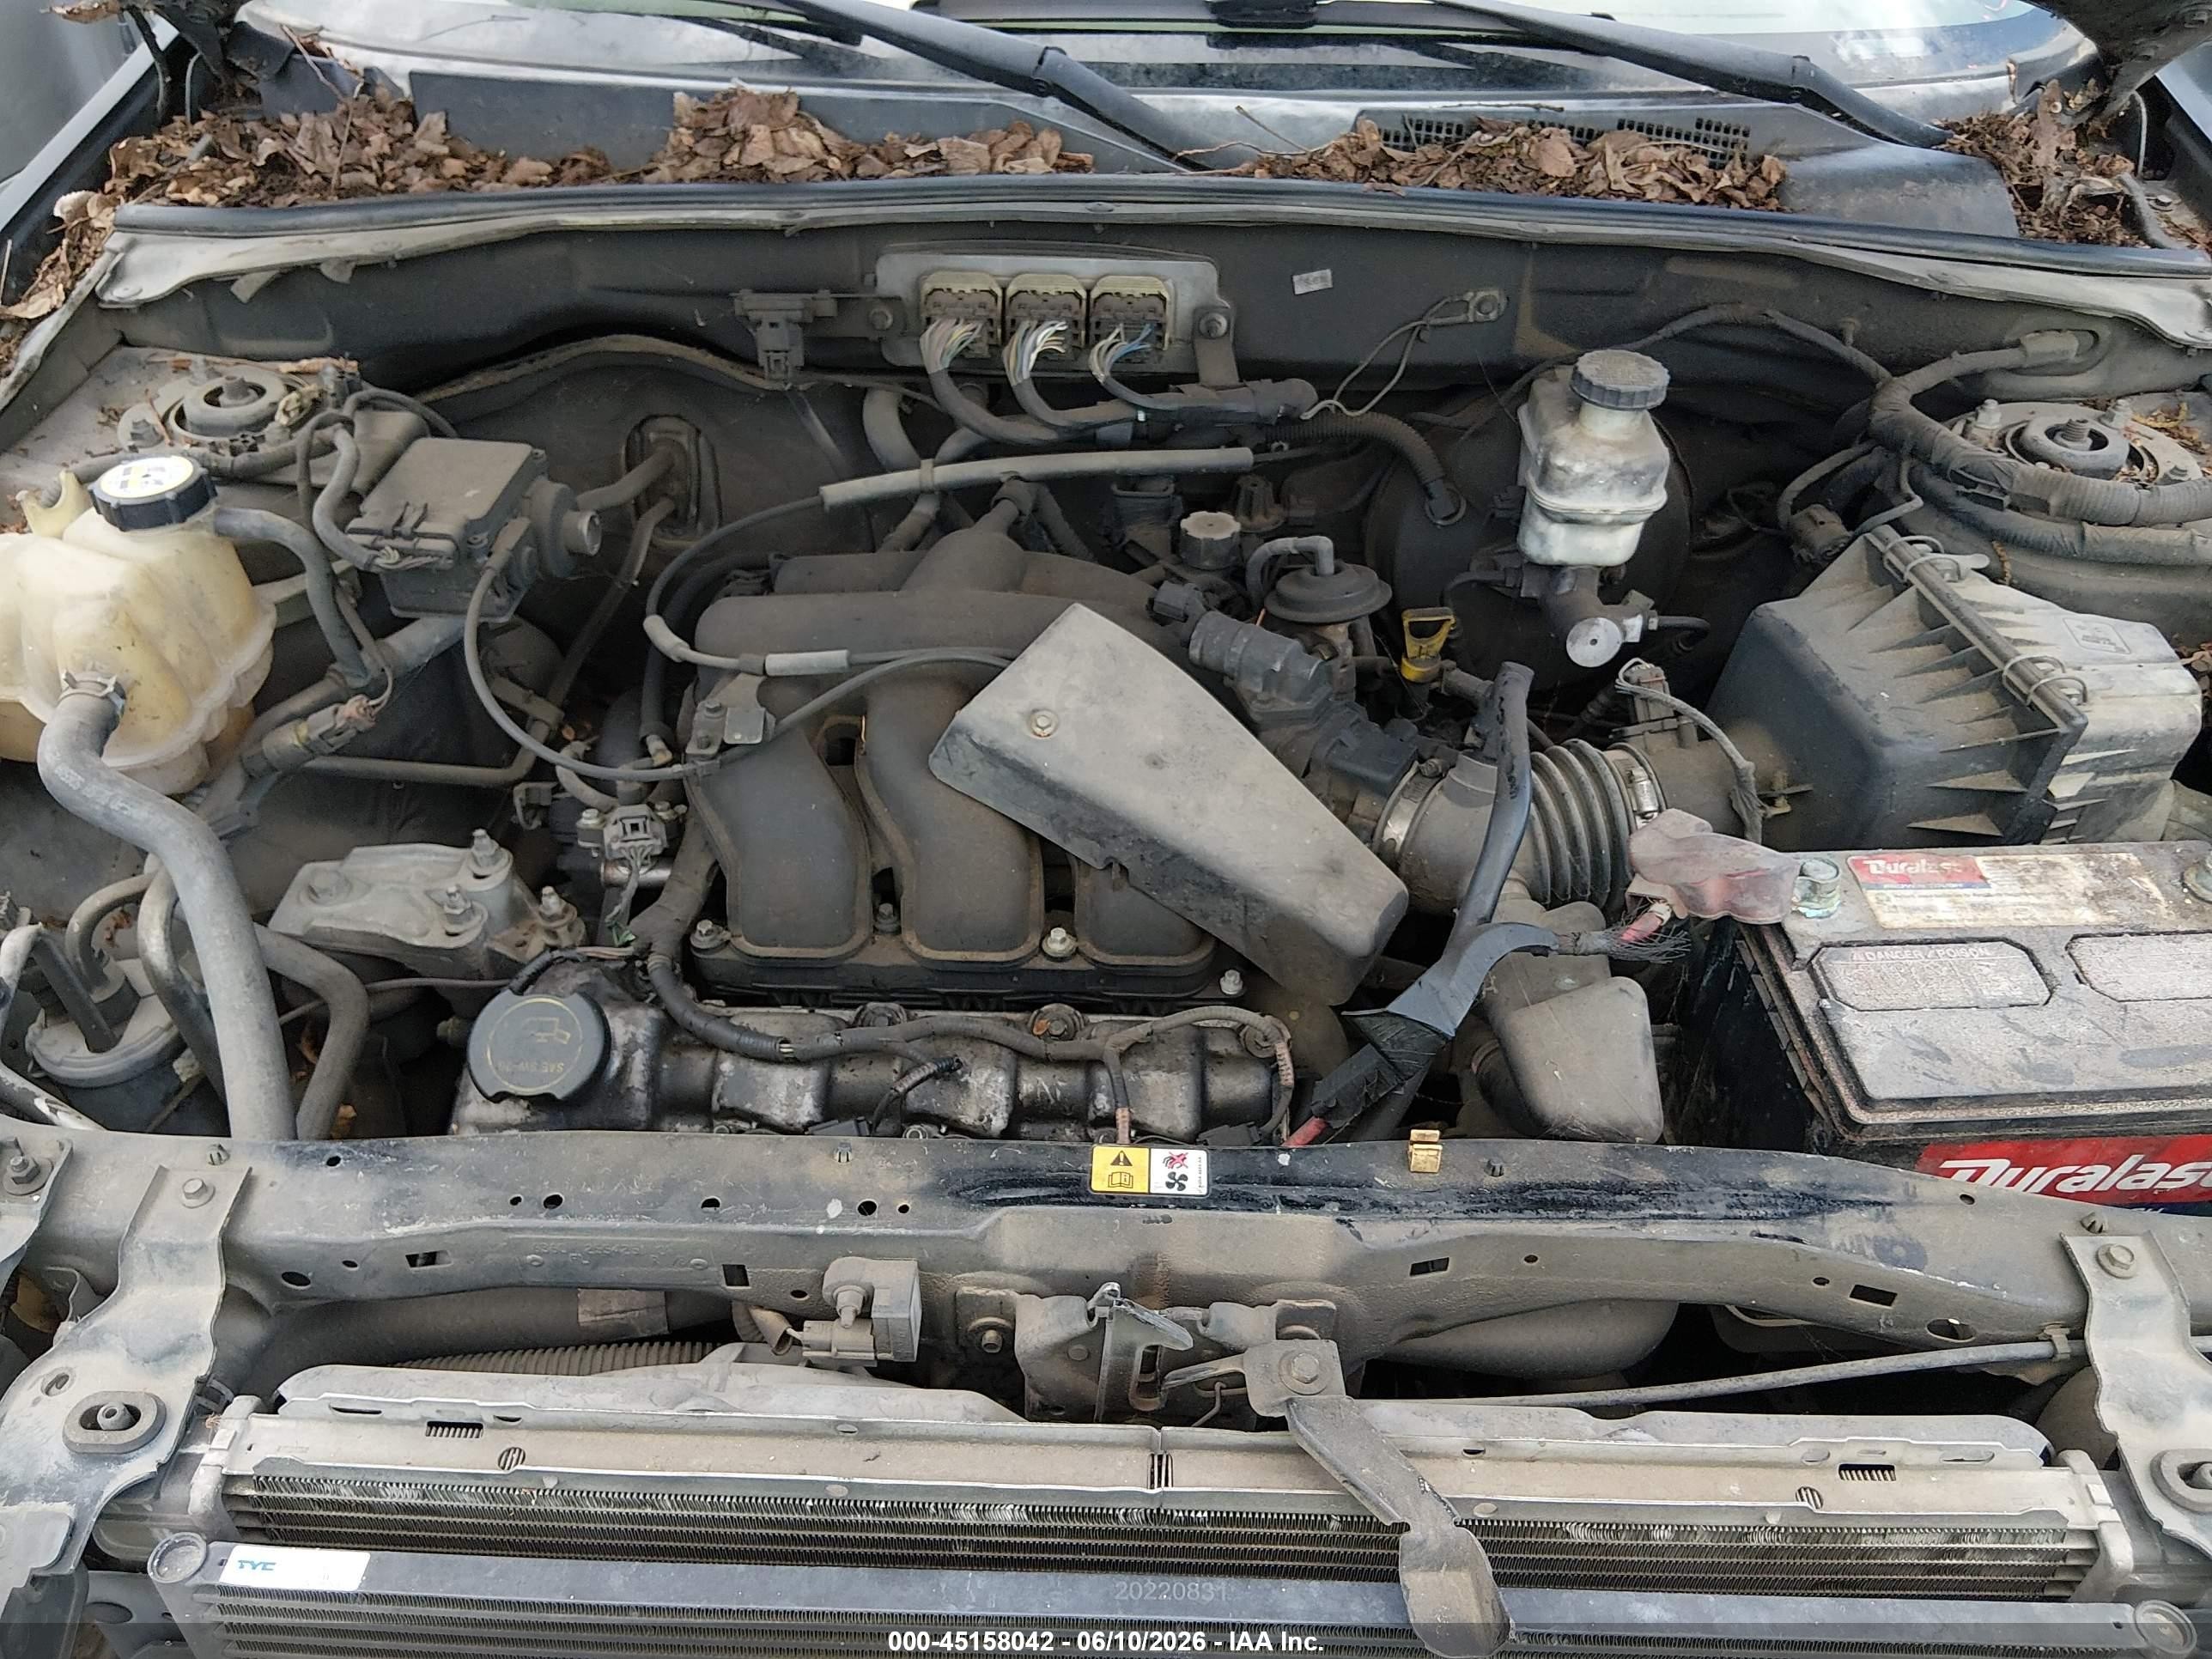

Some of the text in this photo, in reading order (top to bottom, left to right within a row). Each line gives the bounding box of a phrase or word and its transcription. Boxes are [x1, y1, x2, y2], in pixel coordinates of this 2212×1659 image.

[1865, 948, 1924, 961] DANGER
[1936, 946, 1994, 959] POISON
[238, 1559, 276, 1571] TYC
[1115, 1580, 1227, 1601] 20220831
